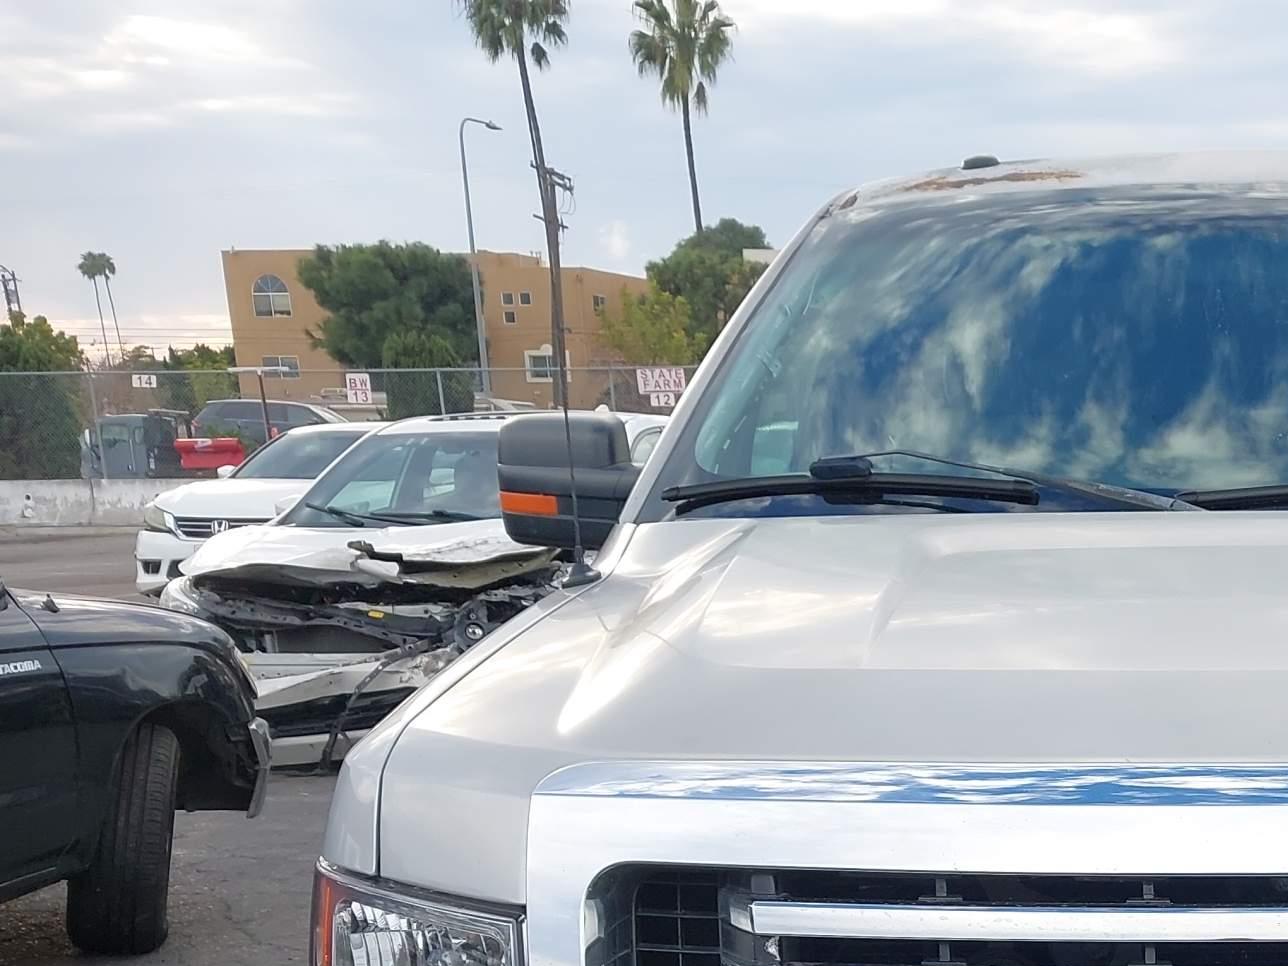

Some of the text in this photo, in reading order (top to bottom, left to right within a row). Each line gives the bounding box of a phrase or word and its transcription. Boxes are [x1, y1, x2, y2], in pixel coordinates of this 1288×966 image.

[640, 368, 684, 380] STATE
[136, 375, 153, 387] 14
[349, 378, 368, 389] BW
[643, 380, 683, 390] FARM
[352, 391, 369, 402] 13
[654, 393, 671, 406] 12
